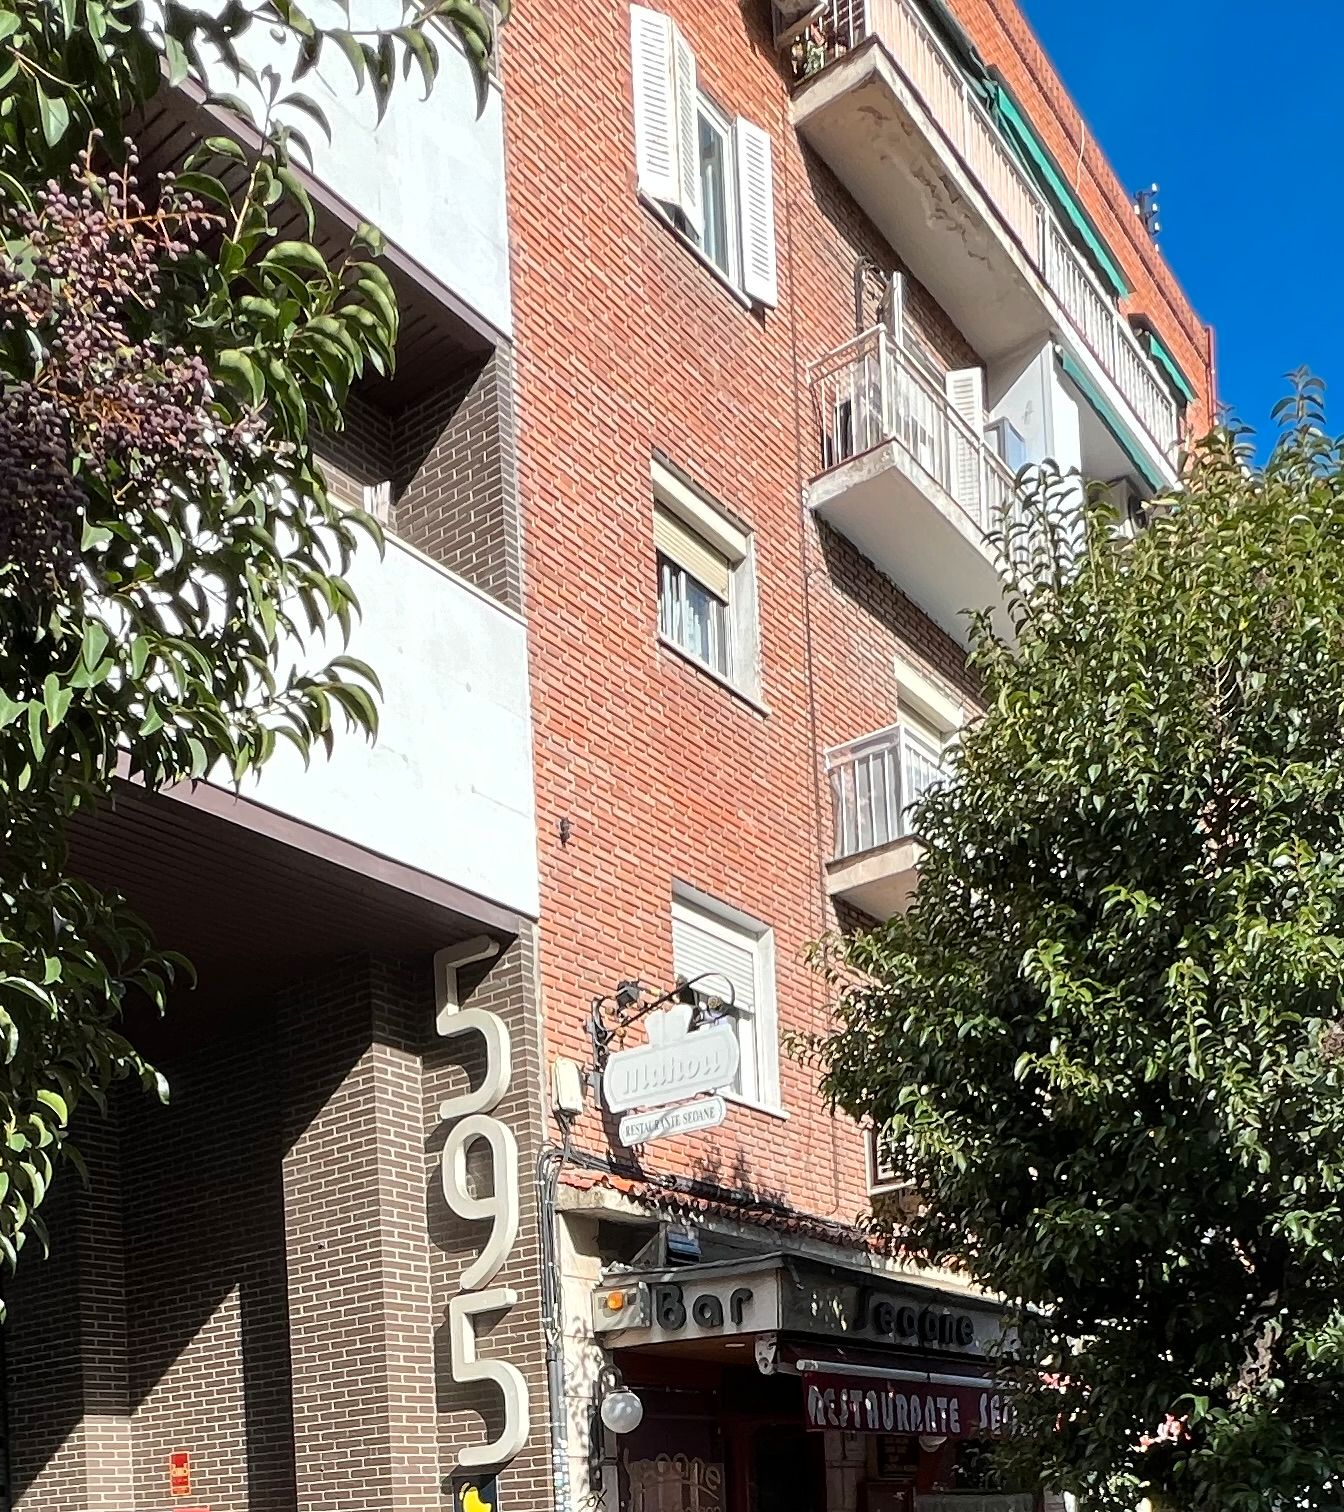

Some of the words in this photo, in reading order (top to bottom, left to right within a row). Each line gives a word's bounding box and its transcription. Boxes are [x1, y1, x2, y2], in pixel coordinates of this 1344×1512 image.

[625, 1113, 681, 1138] RESTAURANTE
[682, 1105, 716, 1125] SEOANE
[434, 934, 530, 1468] 595
[656, 1283, 755, 1332] Bar
[807, 1384, 963, 1434] RESTAURANTE
